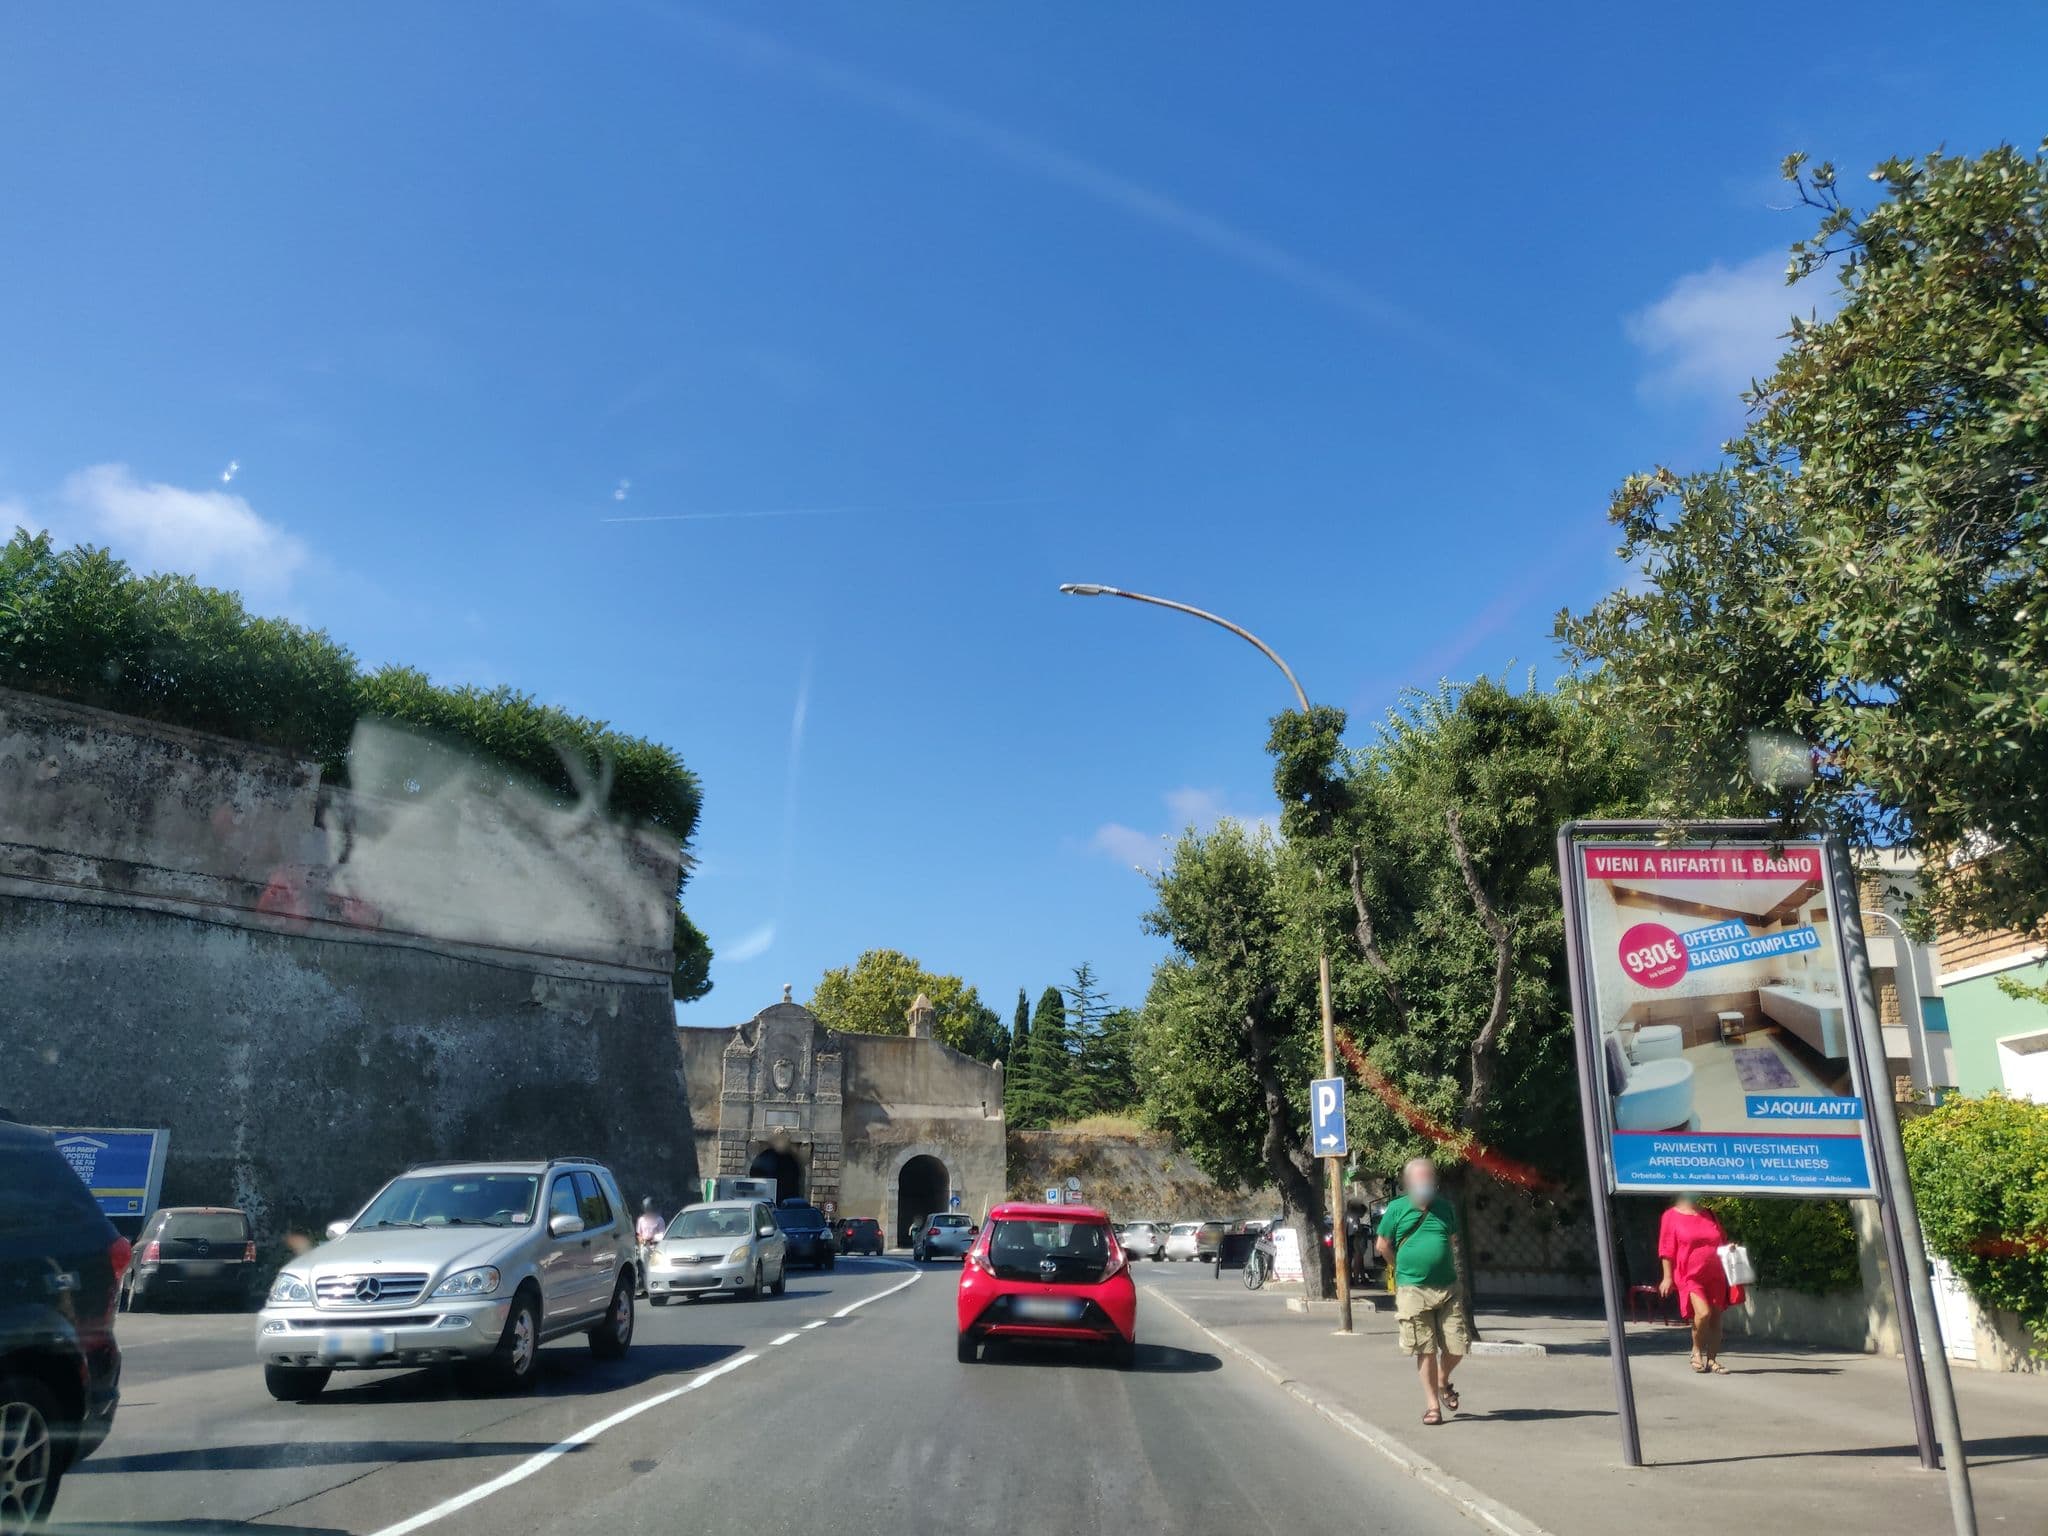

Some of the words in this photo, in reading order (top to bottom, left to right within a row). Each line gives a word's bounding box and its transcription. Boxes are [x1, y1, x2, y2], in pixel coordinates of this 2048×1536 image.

[1595, 857, 1639, 872] VIENI
[1644, 857, 1656, 872] A
[1660, 857, 1726, 873] RIFARTI
[1732, 858, 1748, 873] IL
[1752, 858, 1812, 873] BAGNO
[1683, 924, 1745, 947] OFFERTA
[1626, 938, 1682, 973] 930€
[1690, 944, 1740, 966] BAGNO
[1743, 930, 1817, 957] COMPLETO
[1319, 1086, 1336, 1127] P
[1769, 1101, 1857, 1115] AQUILANTI
[1653, 1142, 1717, 1153] PAVIMENTI
[1733, 1143, 1819, 1155] RIVESTIMENTI
[1648, 1156, 1745, 1168] ARREDOBAGNO
[1760, 1158, 1830, 1169] WELLNESS
[1825, 1175, 1852, 1183] Albinia
